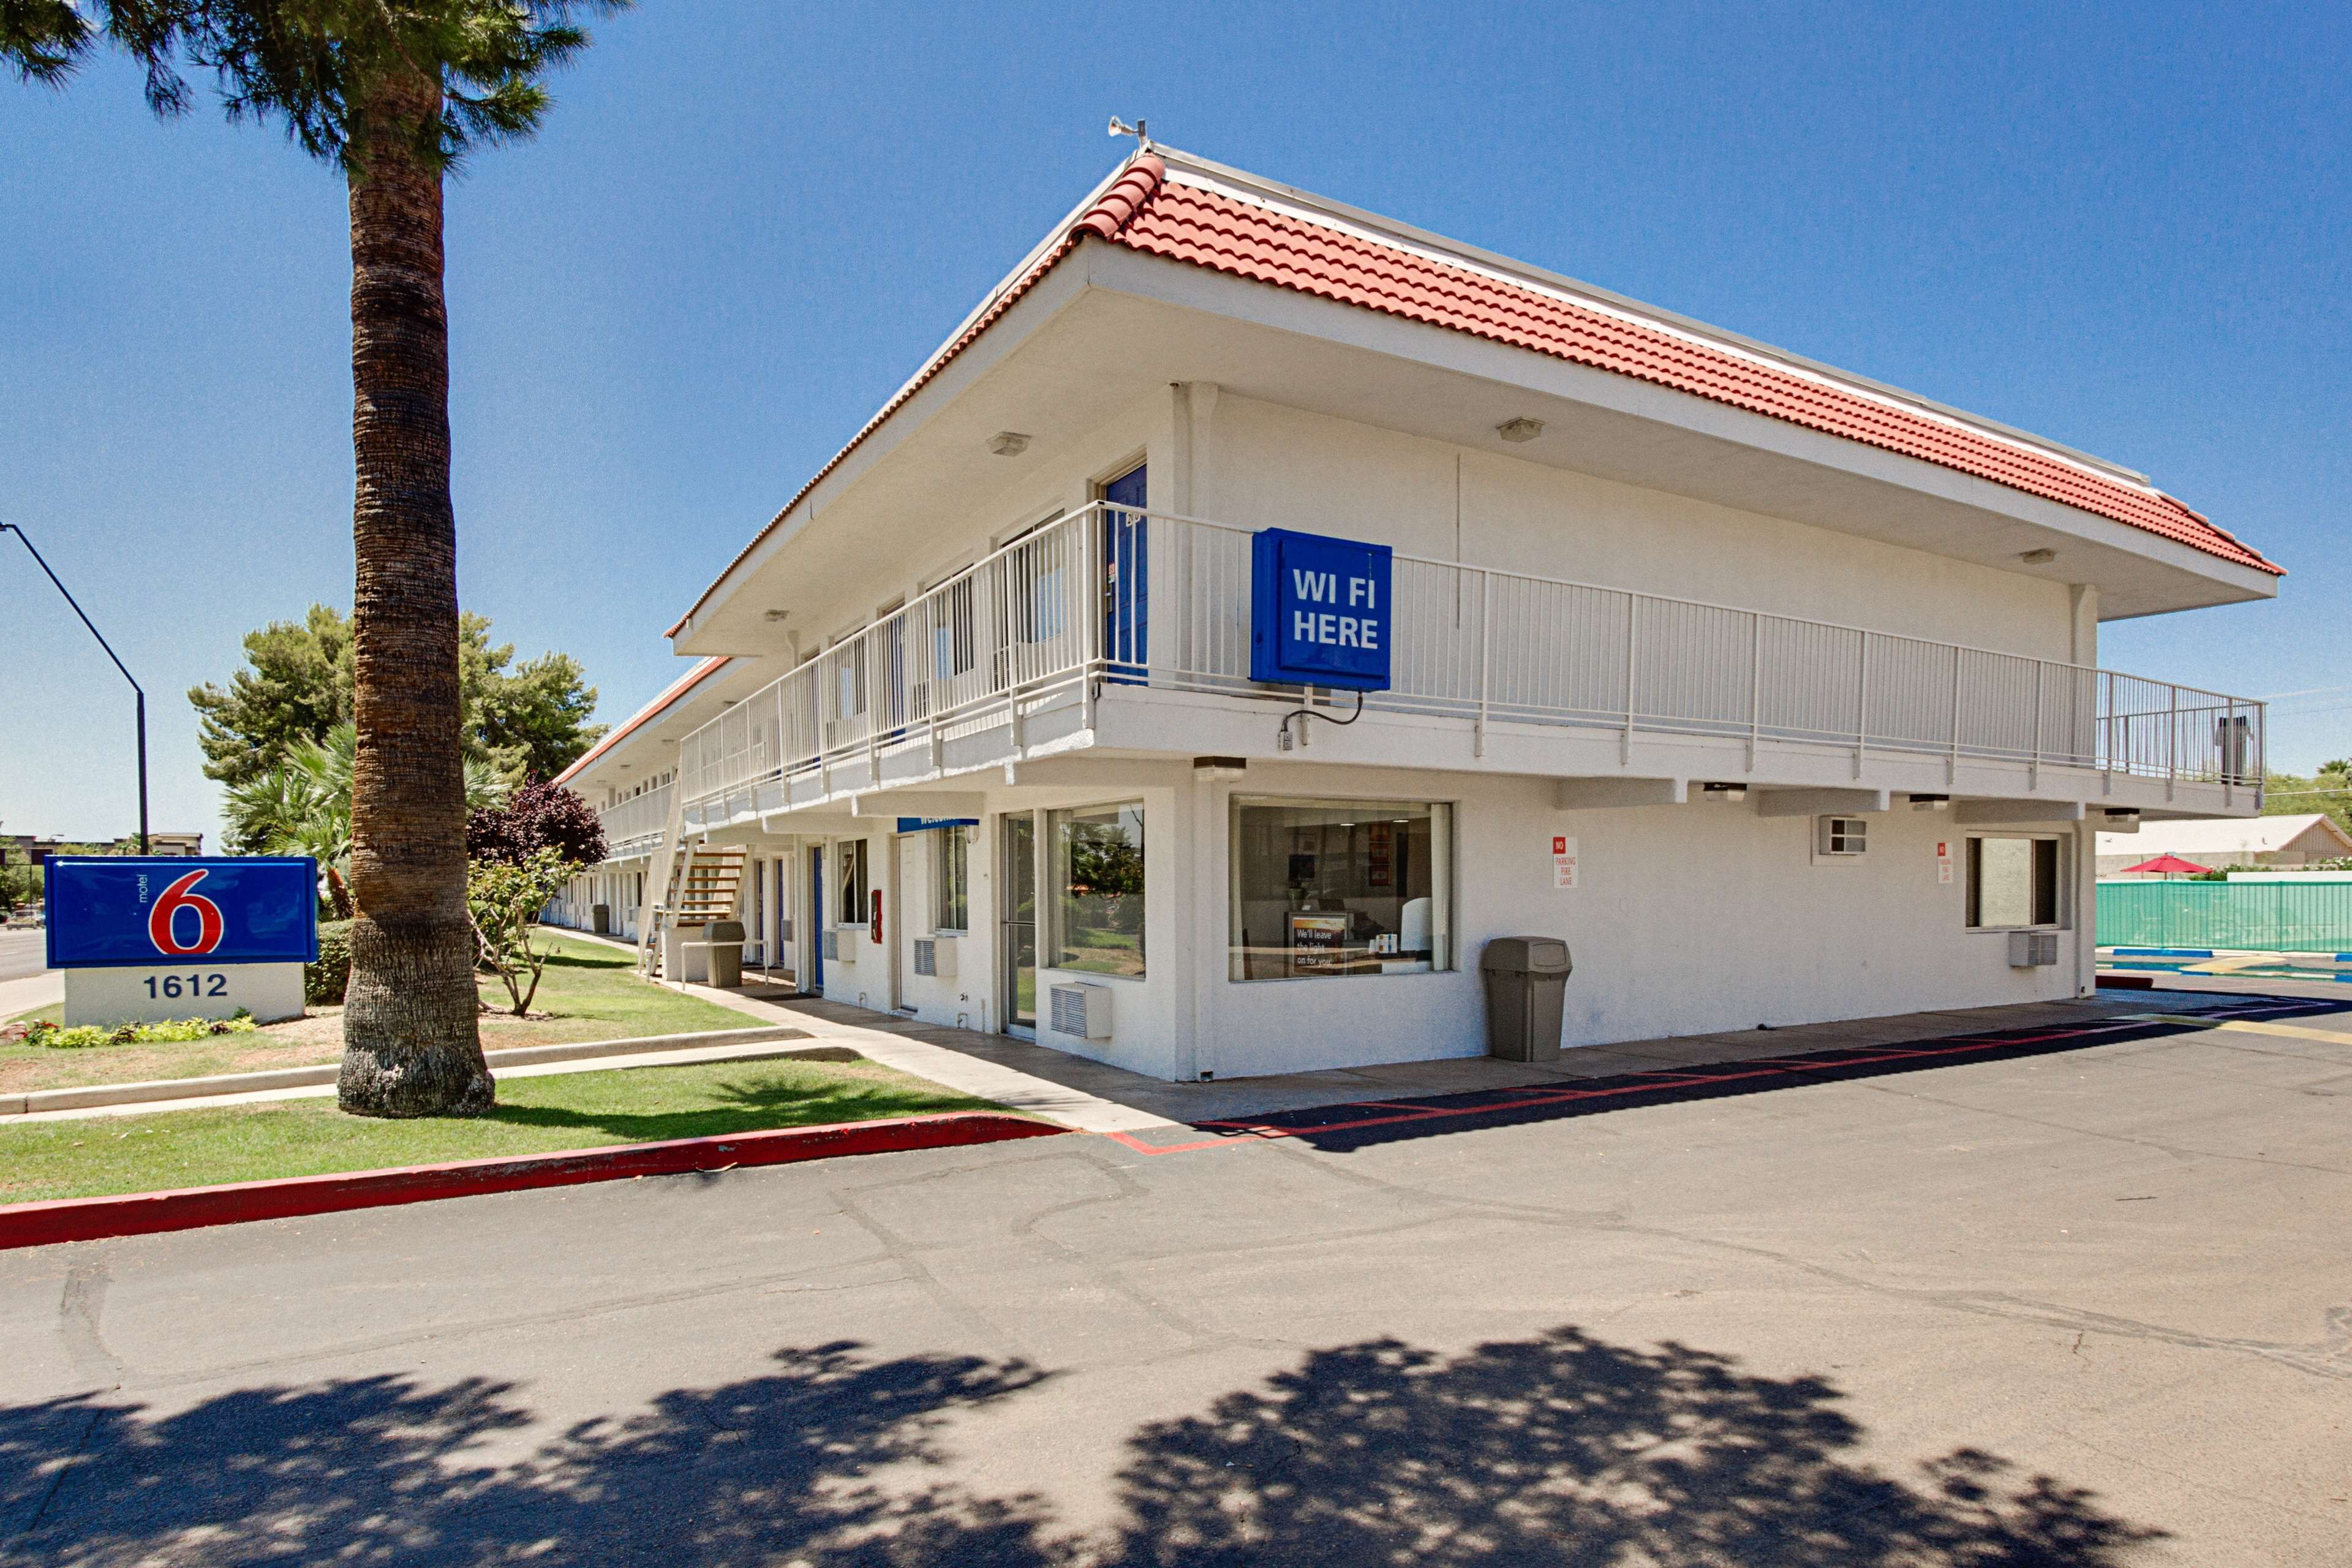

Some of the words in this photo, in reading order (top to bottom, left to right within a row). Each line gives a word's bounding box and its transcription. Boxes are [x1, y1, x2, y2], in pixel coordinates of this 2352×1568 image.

[1293, 569, 1336, 603] WI
[1349, 577, 1375, 609] FI
[1294, 611, 1378, 649] HERE
[1556, 841, 1564, 850] NO
[137, 874, 148, 903] motel
[148, 869, 224, 955] 6
[1297, 929, 1313, 938] We'll
[1314, 929, 1332, 939] leave
[1297, 941, 1308, 951] the
[1309, 942, 1325, 954] light
[1307, 956, 1317, 965] for
[143, 974, 228, 999] 1612
